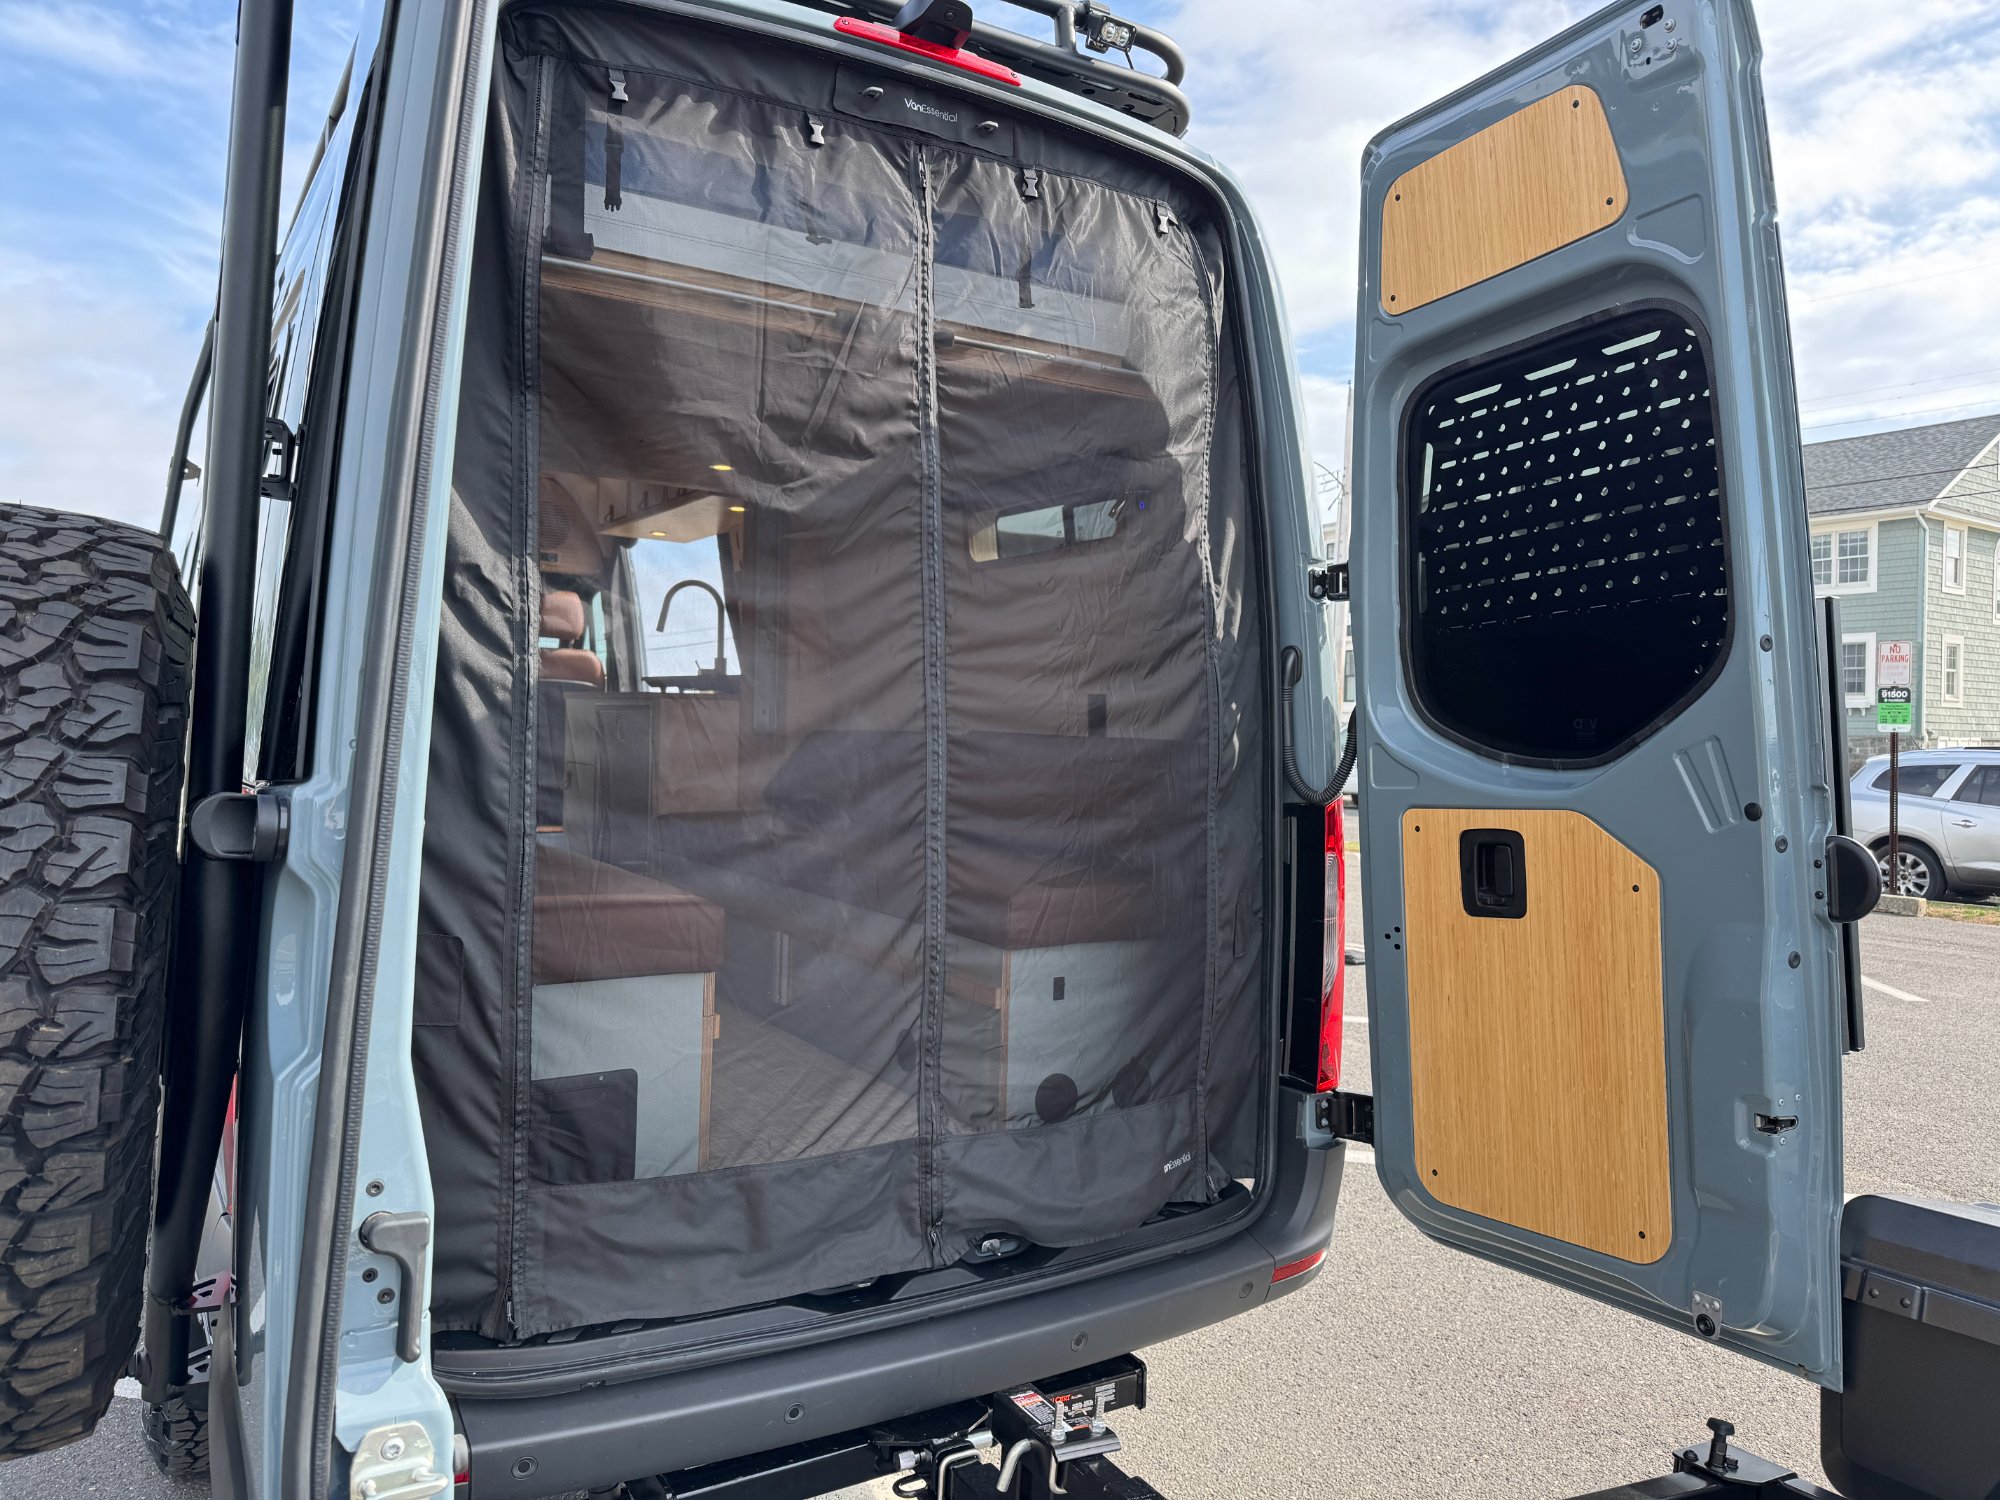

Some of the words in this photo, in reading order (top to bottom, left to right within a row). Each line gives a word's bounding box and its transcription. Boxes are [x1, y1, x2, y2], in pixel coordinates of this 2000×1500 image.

[904, 97, 958, 122] VanEssential
[1889, 645, 1901, 654] NO
[1882, 655, 1909, 663] PARKING
